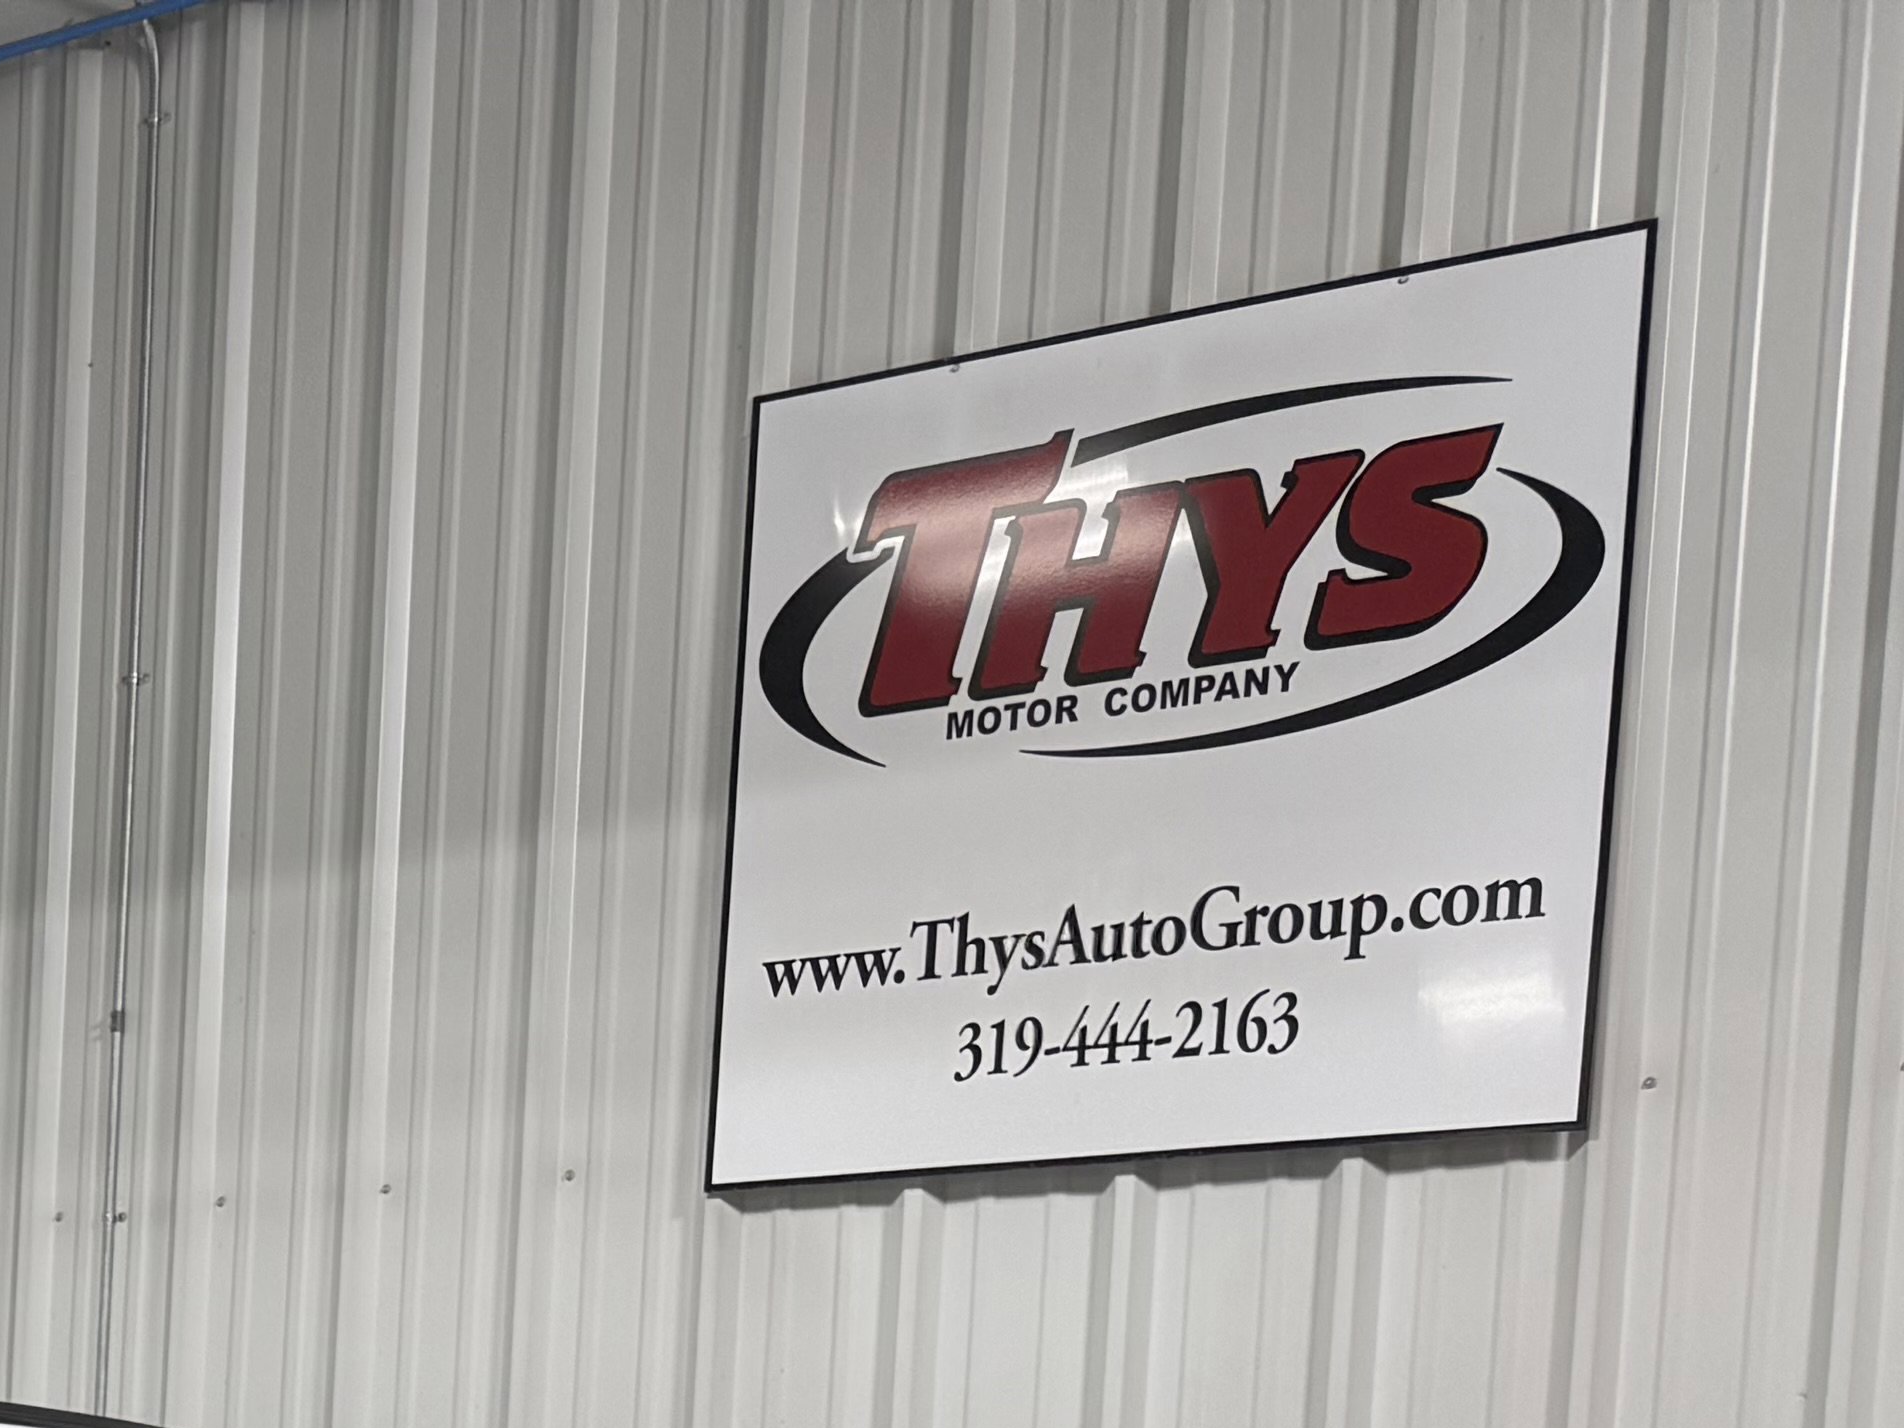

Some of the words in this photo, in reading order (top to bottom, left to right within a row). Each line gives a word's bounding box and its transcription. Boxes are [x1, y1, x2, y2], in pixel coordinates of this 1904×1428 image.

[856, 422, 1504, 718] THYS
[945, 693, 1080, 742] MOTOR
[1102, 660, 1302, 719] COMPANY
[762, 875, 1546, 997] www.ThysAutoGroup.com
[953, 988, 1301, 1082] 319-444-2163
